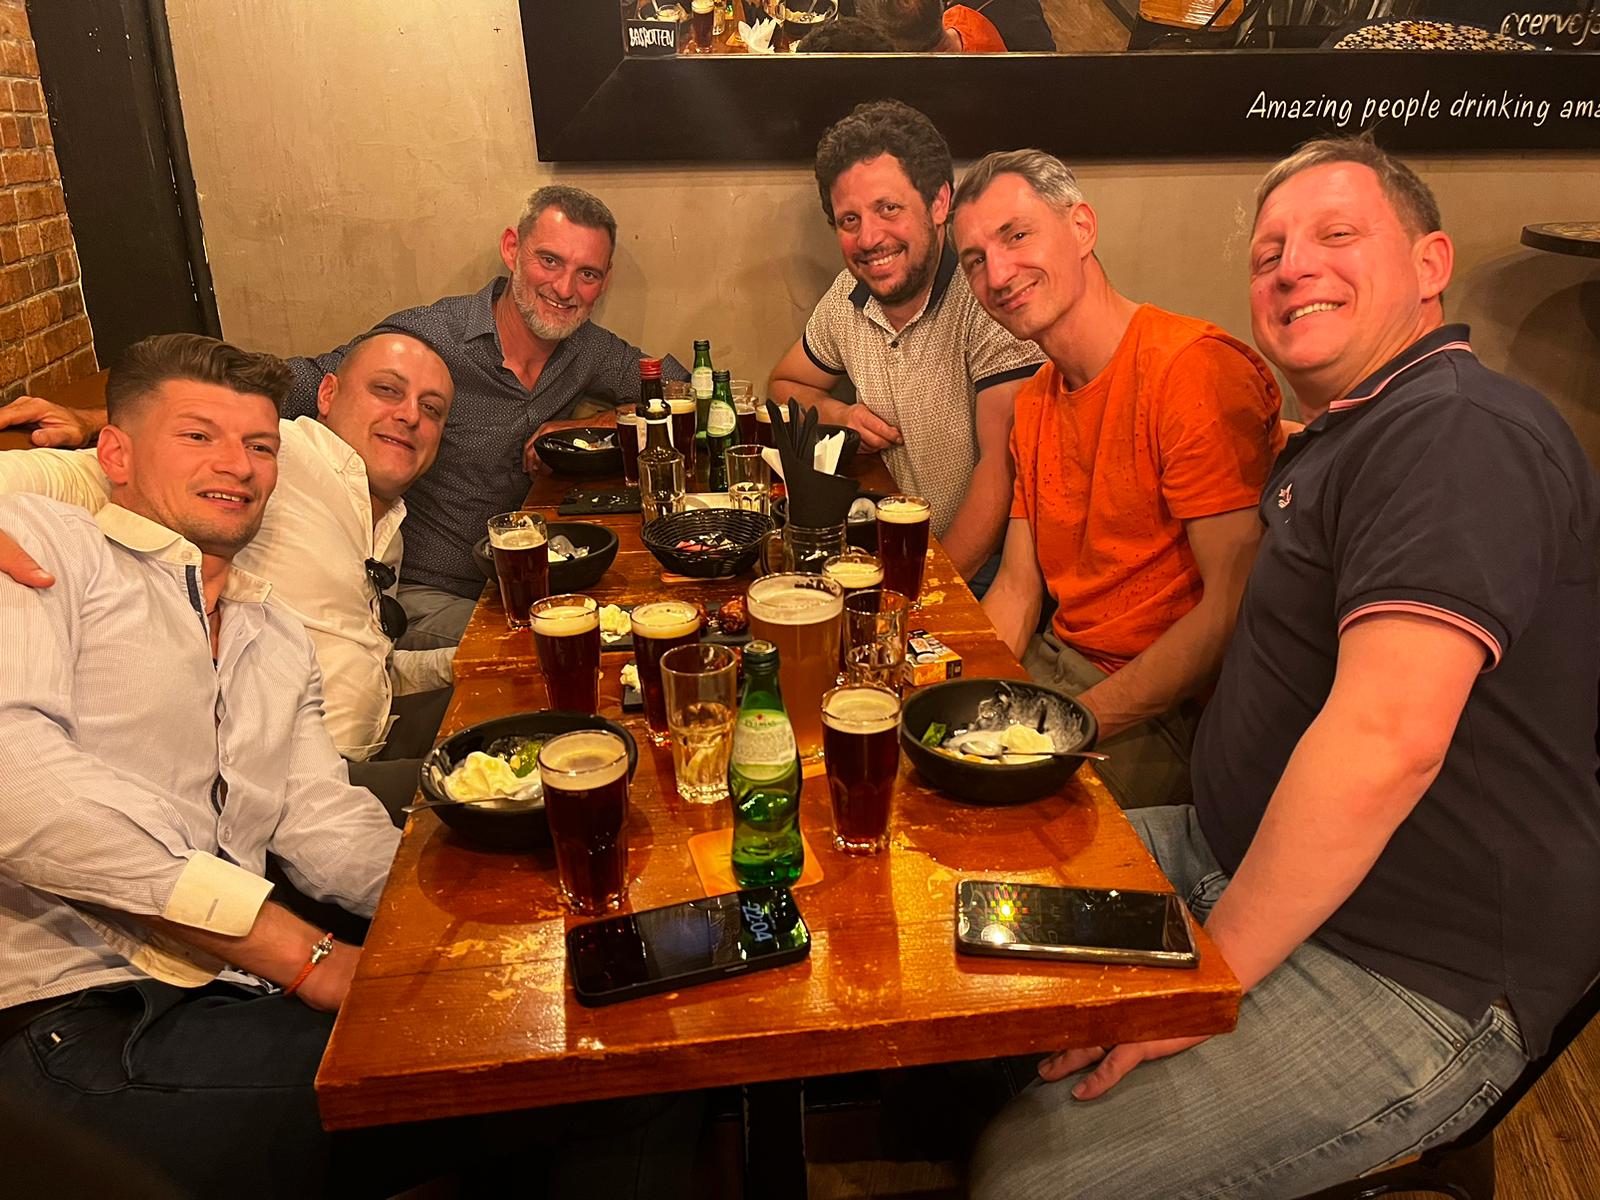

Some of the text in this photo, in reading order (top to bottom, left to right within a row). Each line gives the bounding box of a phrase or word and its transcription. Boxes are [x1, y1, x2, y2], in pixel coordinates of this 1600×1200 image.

[1246, 90, 1352, 127] Amazing
[1360, 89, 1441, 127] people
[1450, 89, 1550, 127] drinking
[742, 902, 773, 941] 22:04
